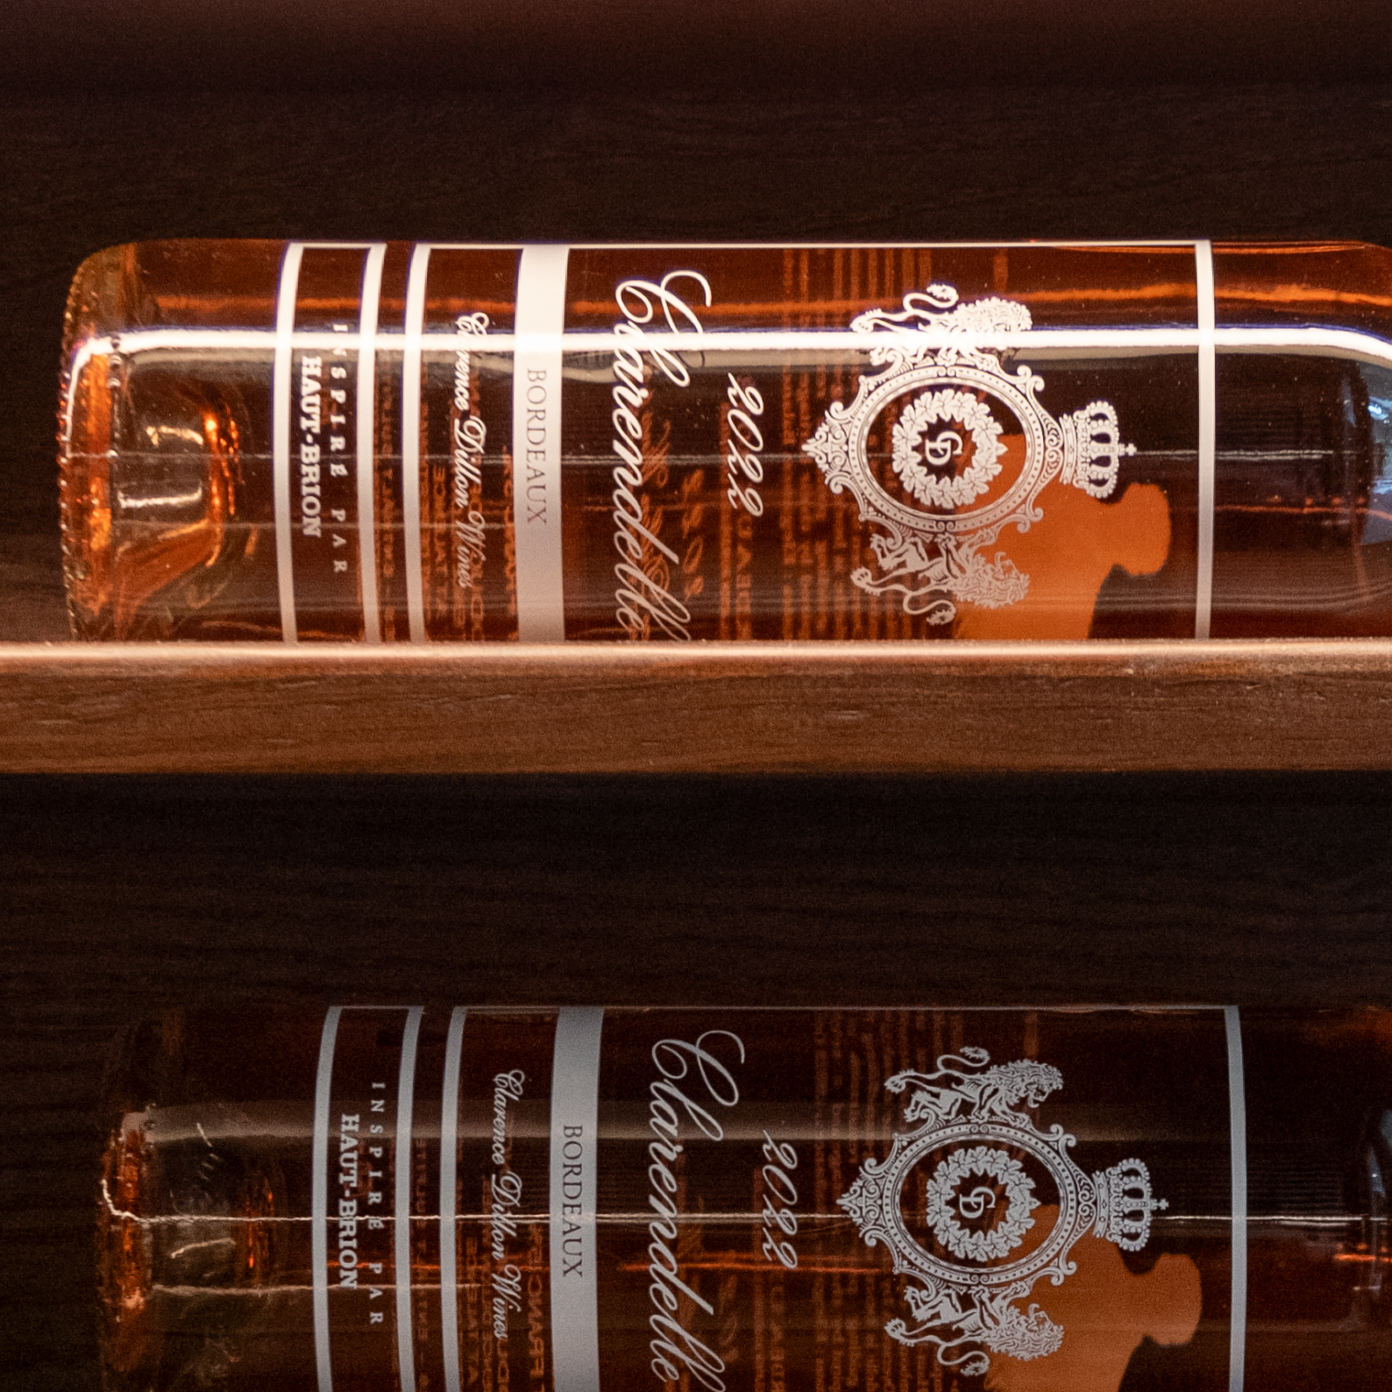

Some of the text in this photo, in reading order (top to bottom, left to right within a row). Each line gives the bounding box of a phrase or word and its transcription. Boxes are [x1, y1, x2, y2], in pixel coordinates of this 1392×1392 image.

[299, 356, 323, 538] HAUT-BRION
[451, 312, 489, 588] Clrence Dillon Wines
[525, 368, 547, 525] BORDEAUX
[609, 269, 714, 641] Clarendelle
[726, 372, 765, 518] 2022
[331, 509, 349, 574] PAR
[338, 1112, 360, 1290] HAUT-BRION
[368, 1082, 387, 1327] INSPIRÉ PAR
[490, 1068, 526, 1340] Clarence Dillon Wines
[562, 1124, 584, 1278] BORDEAUX
[647, 1029, 746, 1392] Clarendelle
[761, 1130, 799, 1270] 2022
